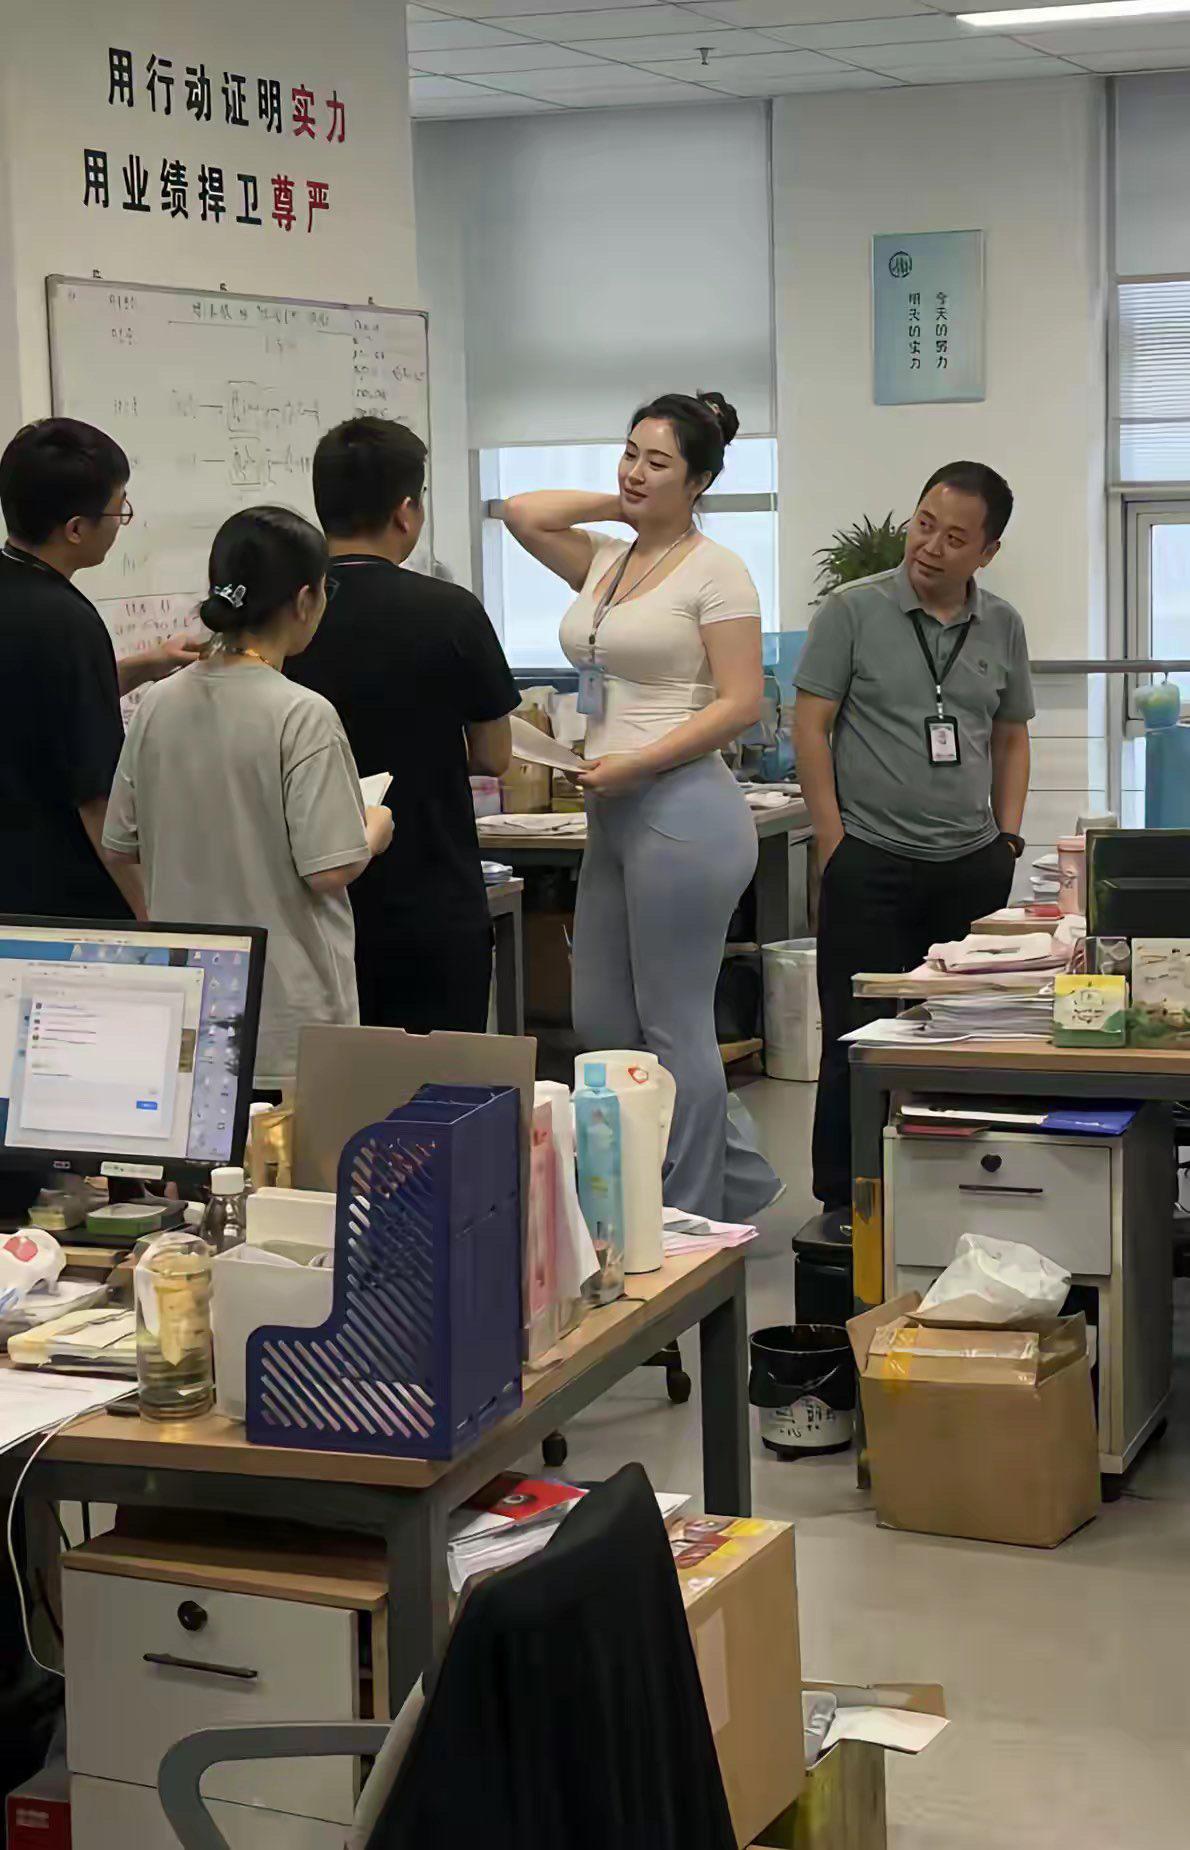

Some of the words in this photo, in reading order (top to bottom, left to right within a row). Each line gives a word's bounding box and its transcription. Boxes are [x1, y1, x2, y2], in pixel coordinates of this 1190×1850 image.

[108, 47, 346, 144] 用行动证明实力
[83, 148, 330, 233] 用业绩捍卫尊严
